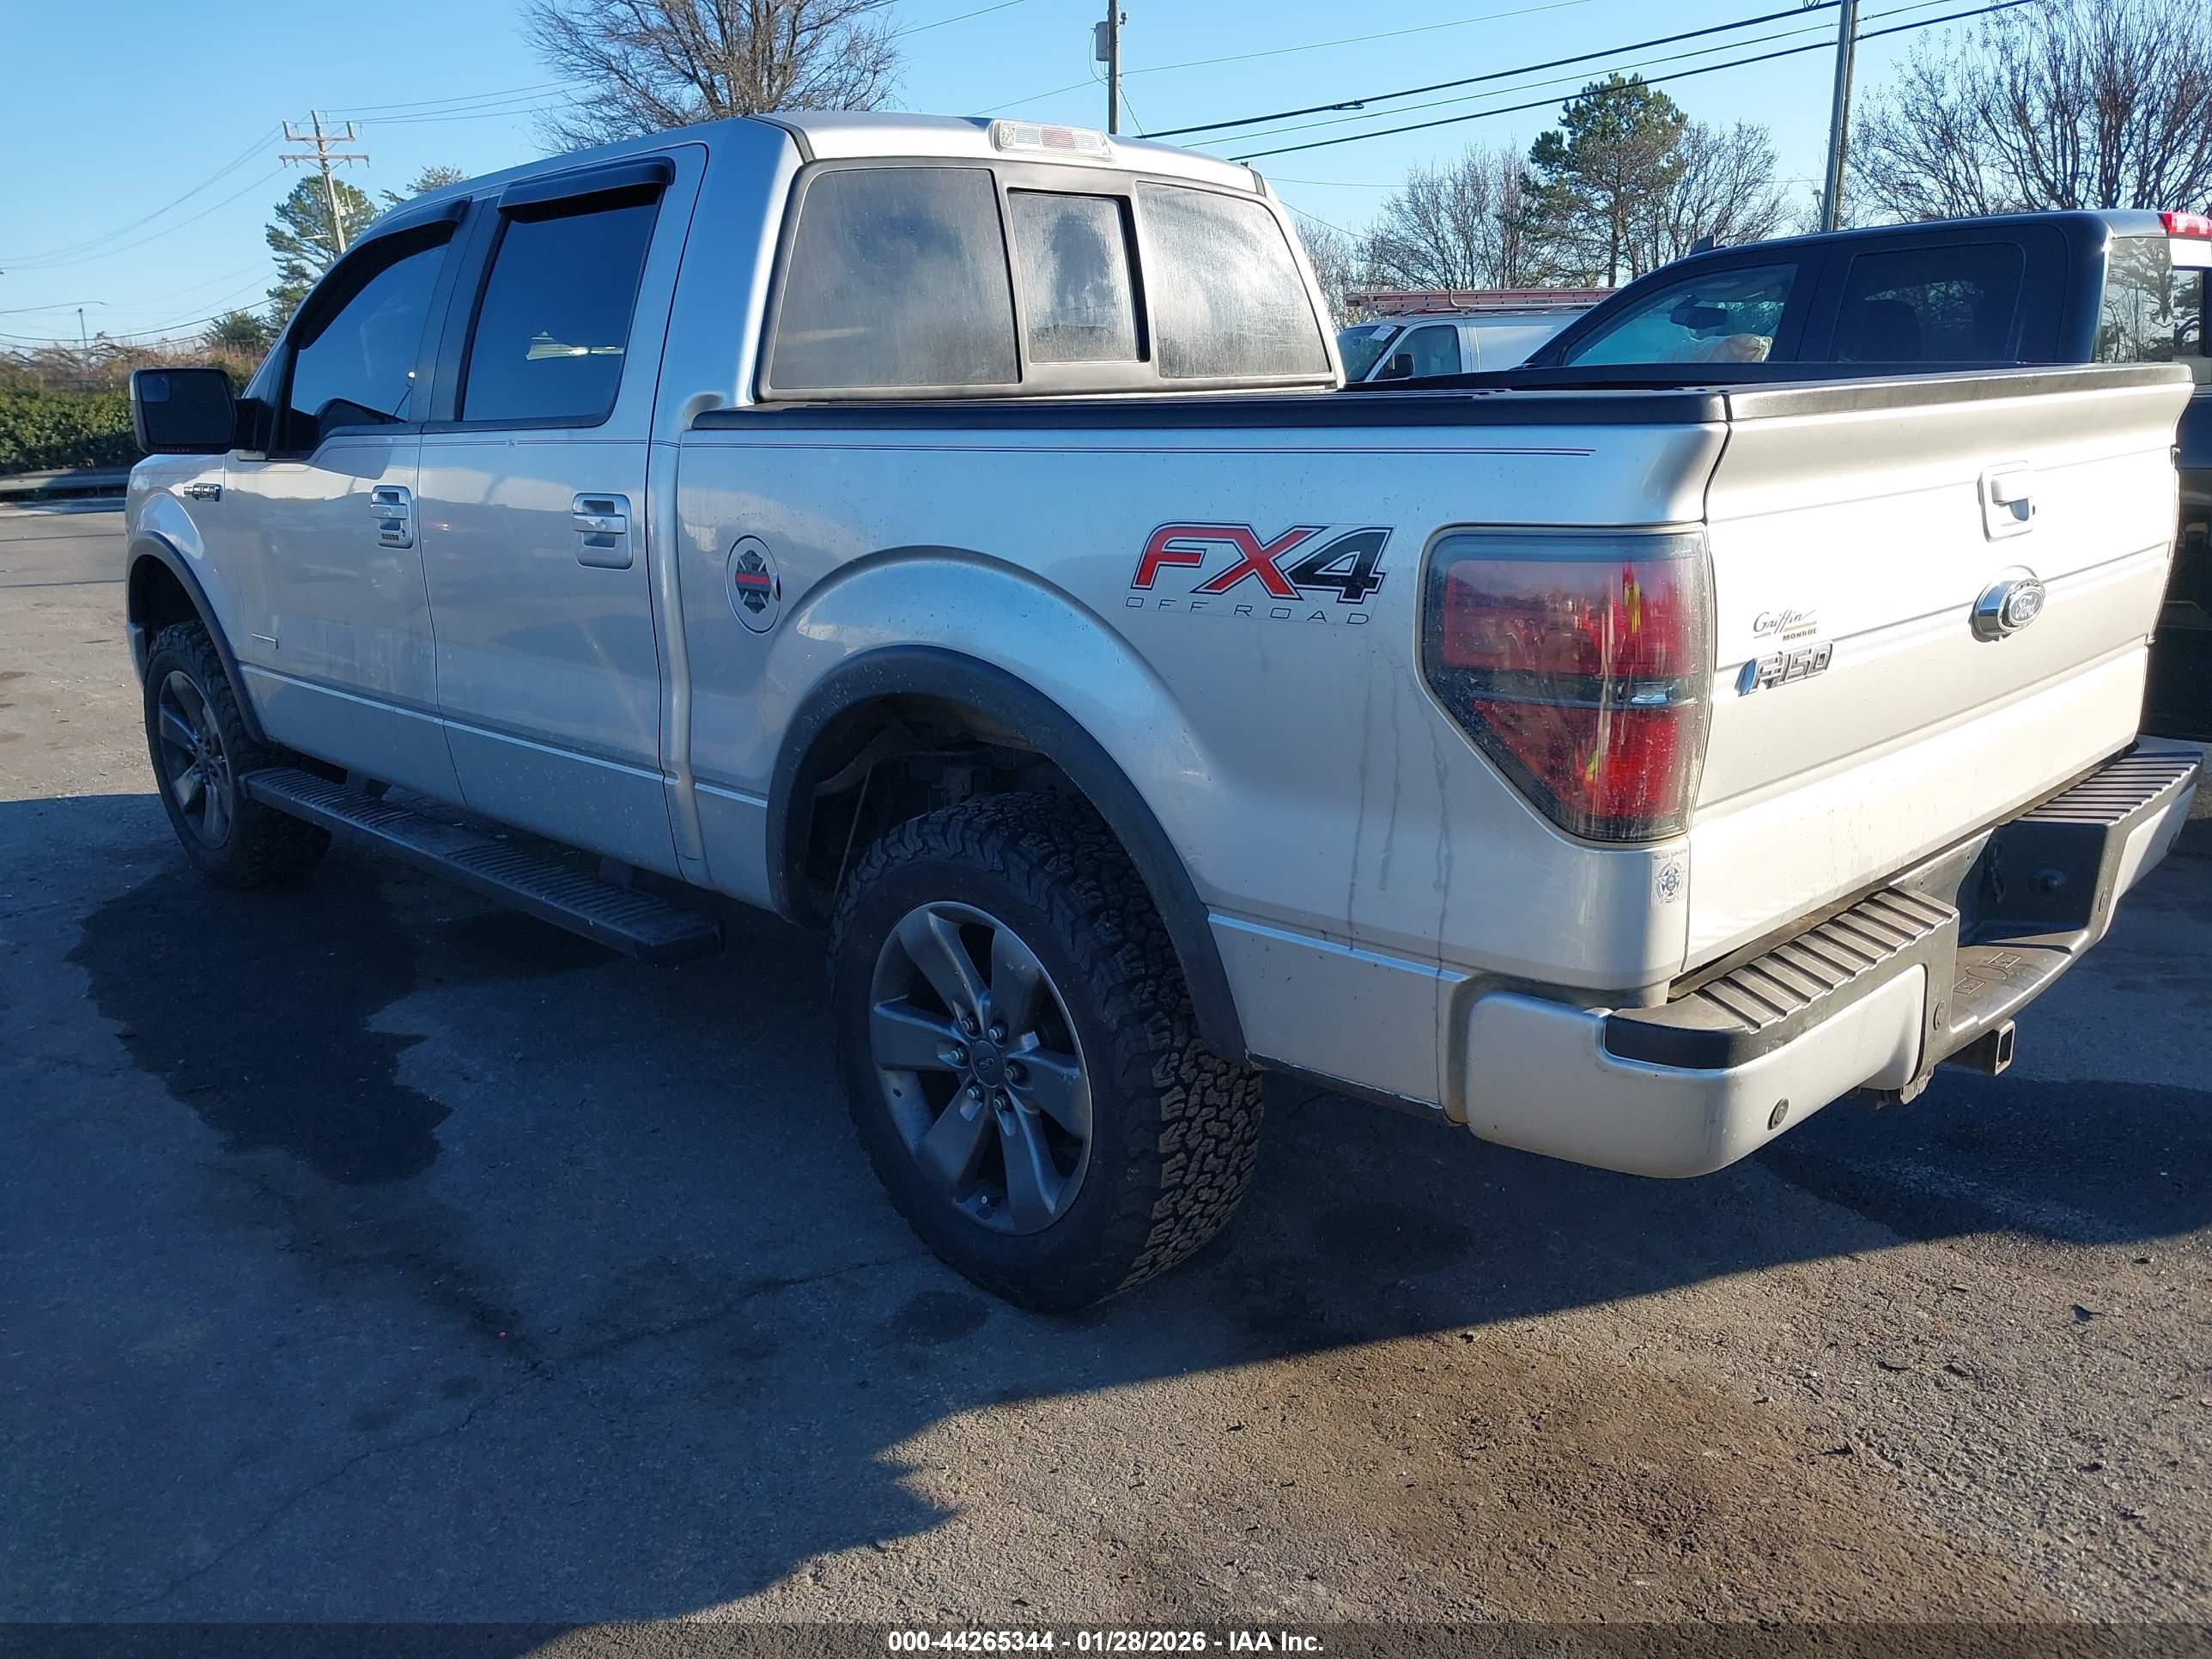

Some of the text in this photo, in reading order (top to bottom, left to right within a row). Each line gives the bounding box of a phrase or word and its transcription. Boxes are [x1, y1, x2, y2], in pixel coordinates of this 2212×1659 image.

[1130, 520, 1396, 605] FX4
[1125, 597, 1370, 626] OFF ROAD
[2014, 594, 2039, 619] Ford
[1753, 610, 1815, 635] Griffin
[1782, 628, 1818, 642] MONROE
[1736, 641, 1832, 696] F-150
